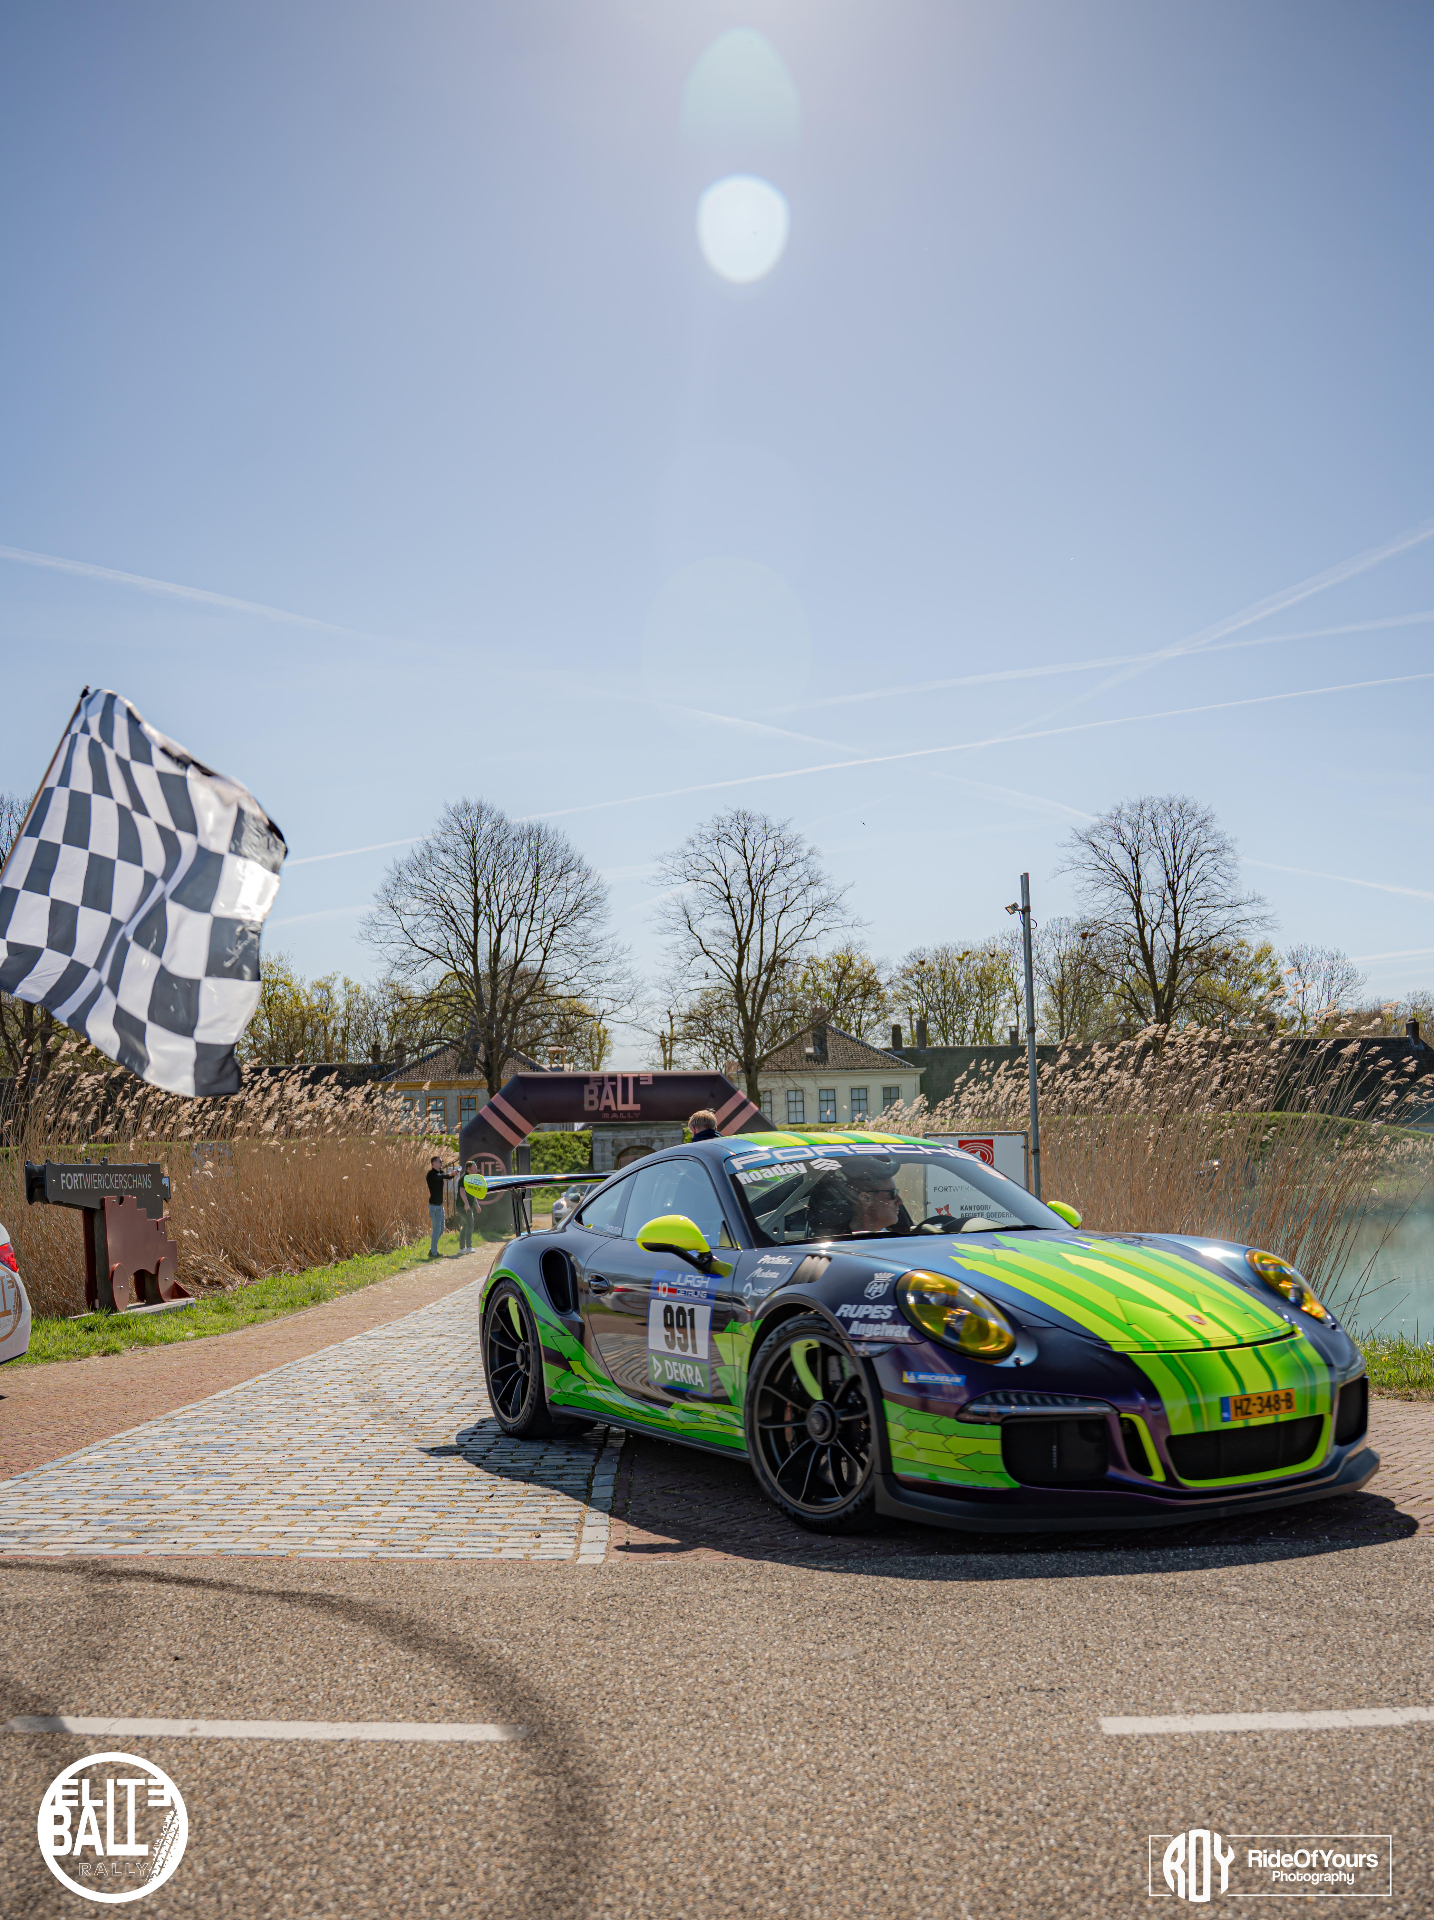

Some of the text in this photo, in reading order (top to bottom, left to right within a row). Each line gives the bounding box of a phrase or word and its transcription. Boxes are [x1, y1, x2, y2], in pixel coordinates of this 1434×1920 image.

[730, 1142, 983, 1171] PORSCHE
[835, 1304, 894, 1320] RUPES
[663, 1304, 698, 1355] 991
[848, 1321, 911, 1338] Angelwax
[664, 1360, 705, 1388] DEKRA
[1234, 1392, 1293, 1417] HZ-348-B
